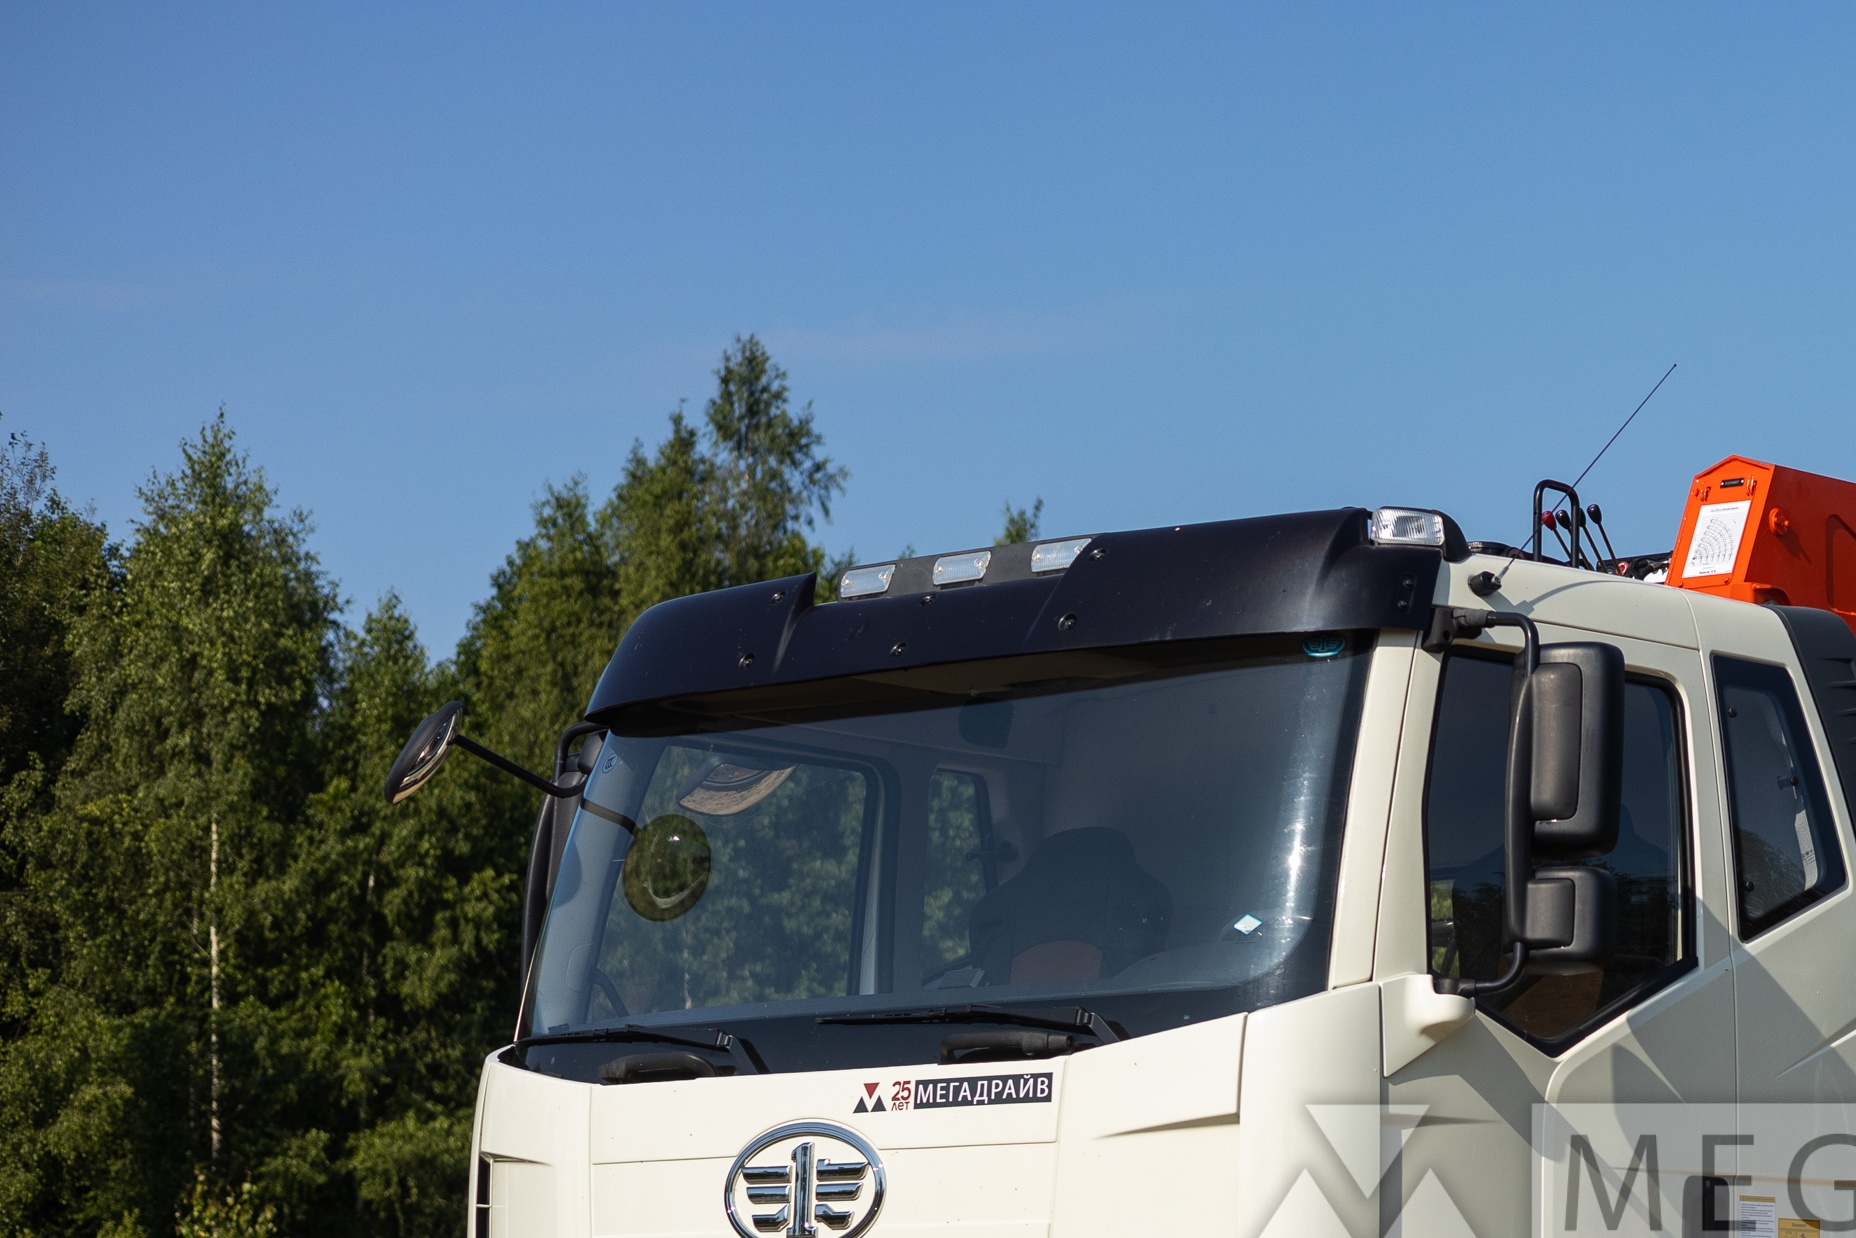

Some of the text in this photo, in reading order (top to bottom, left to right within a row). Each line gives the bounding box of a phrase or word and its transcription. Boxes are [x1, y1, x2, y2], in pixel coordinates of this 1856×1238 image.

[891, 1080, 912, 1102] 25
[916, 1074, 1050, 1105] МЕГАДРАЙВ
[891, 1100, 910, 1111] лет
